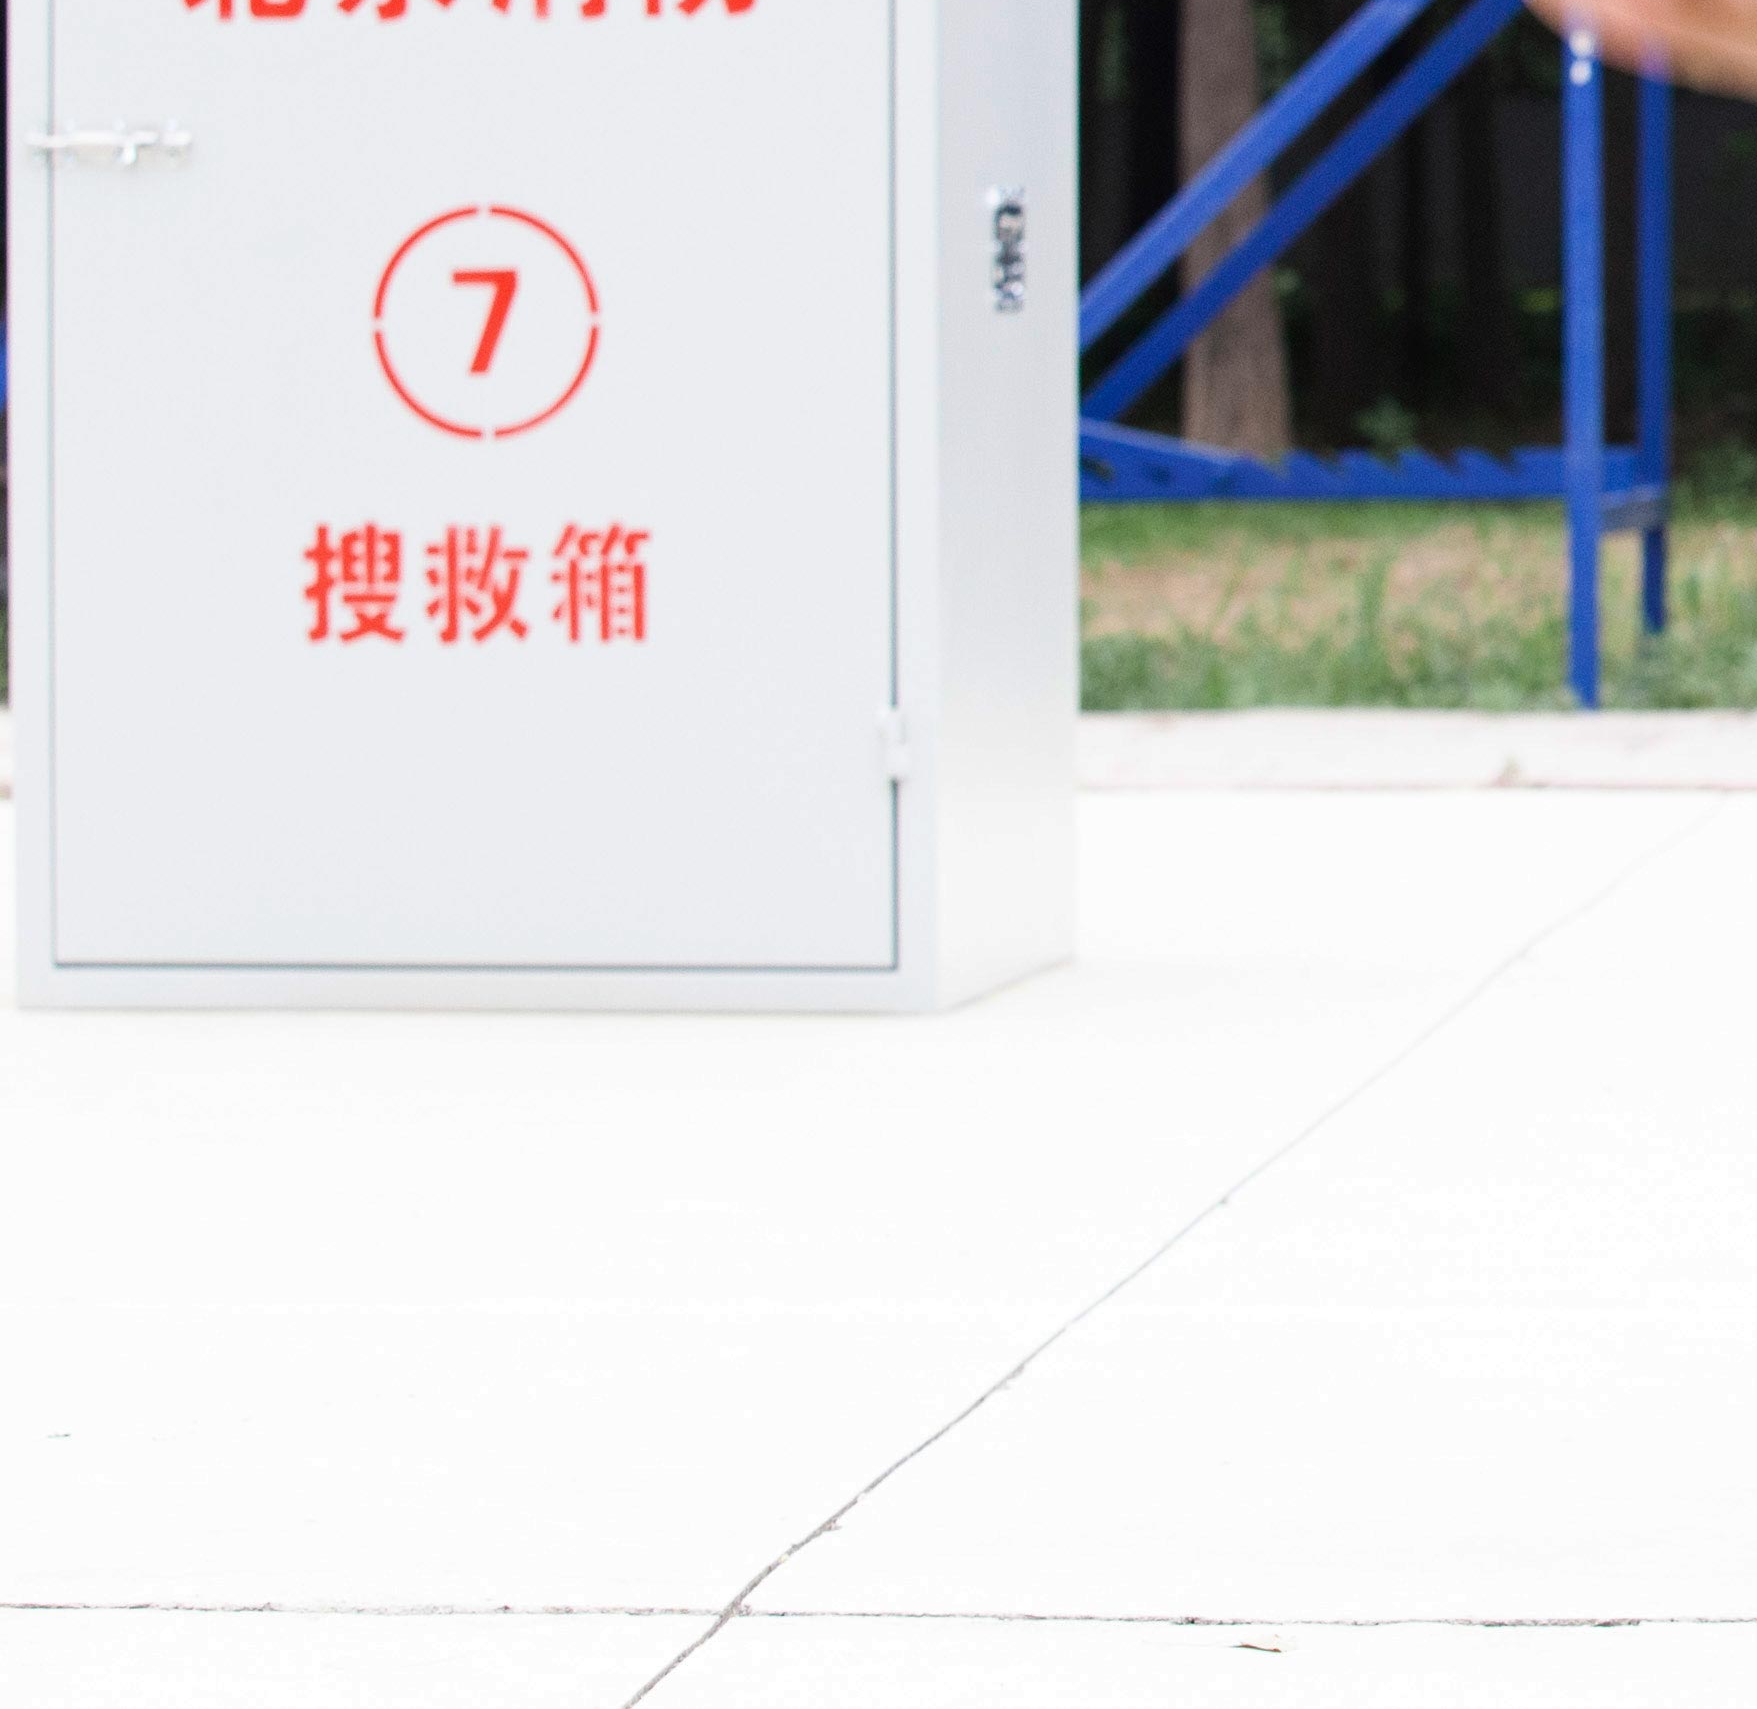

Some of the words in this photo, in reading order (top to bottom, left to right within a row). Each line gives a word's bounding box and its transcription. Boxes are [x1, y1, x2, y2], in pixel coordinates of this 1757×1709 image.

[450, 267, 520, 377] 7
[302, 520, 651, 647] 搜救箱
